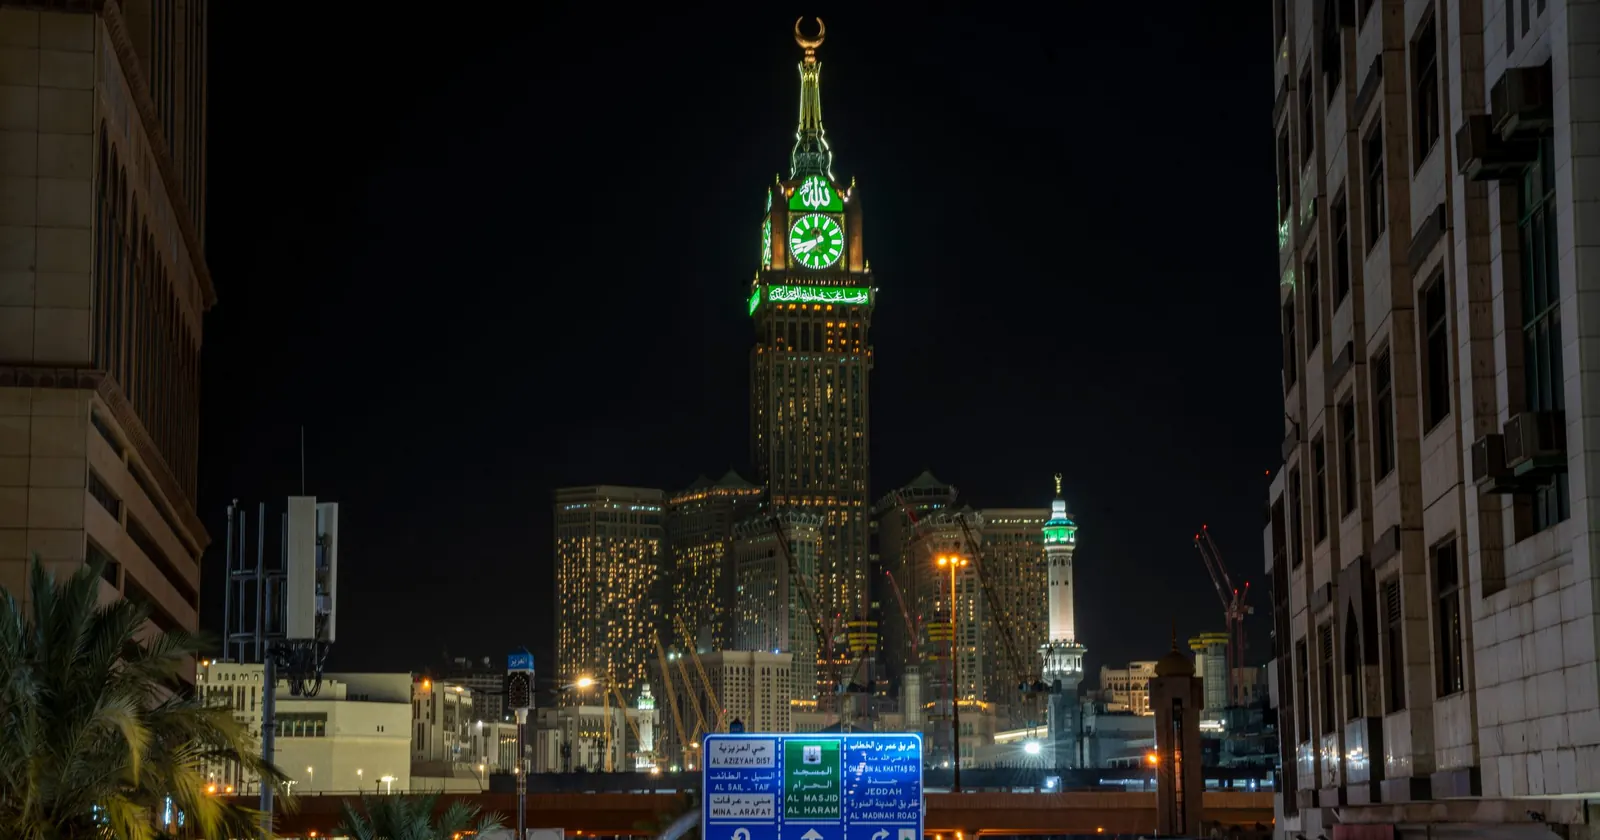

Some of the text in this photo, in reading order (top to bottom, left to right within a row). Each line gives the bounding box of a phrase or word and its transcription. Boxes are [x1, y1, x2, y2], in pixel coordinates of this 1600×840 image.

[719, 743, 765, 755] حي العزيزية
[850, 741, 916, 751] طريق عمر بن الخطاب
[712, 757, 720, 765] AL
[724, 757, 754, 765] AZIZYAH
[793, 766, 832, 776] المسجد
[883, 765, 908, 773] KHATTAB
[710, 771, 741, 780] الطائف
[751, 771, 775, 782] السيل
[867, 776, 898, 785] جدة
[714, 783, 725, 791] AL
[727, 783, 744, 791] SAIL
[754, 783, 770, 791] TAIF
[793, 780, 832, 792] الحرام
[865, 788, 902, 796] JEDDAH
[713, 795, 742, 806] عرفات
[787, 794, 838, 802] AL MASJID
[850, 799, 874, 809] المنورة
[875, 799, 897, 809] المدينة
[712, 808, 731, 816] MINA
[739, 808, 772, 816] ARAFAT
[787, 806, 838, 814] AL HARAM
[849, 812, 917, 820] AL MADINAH ROAD
